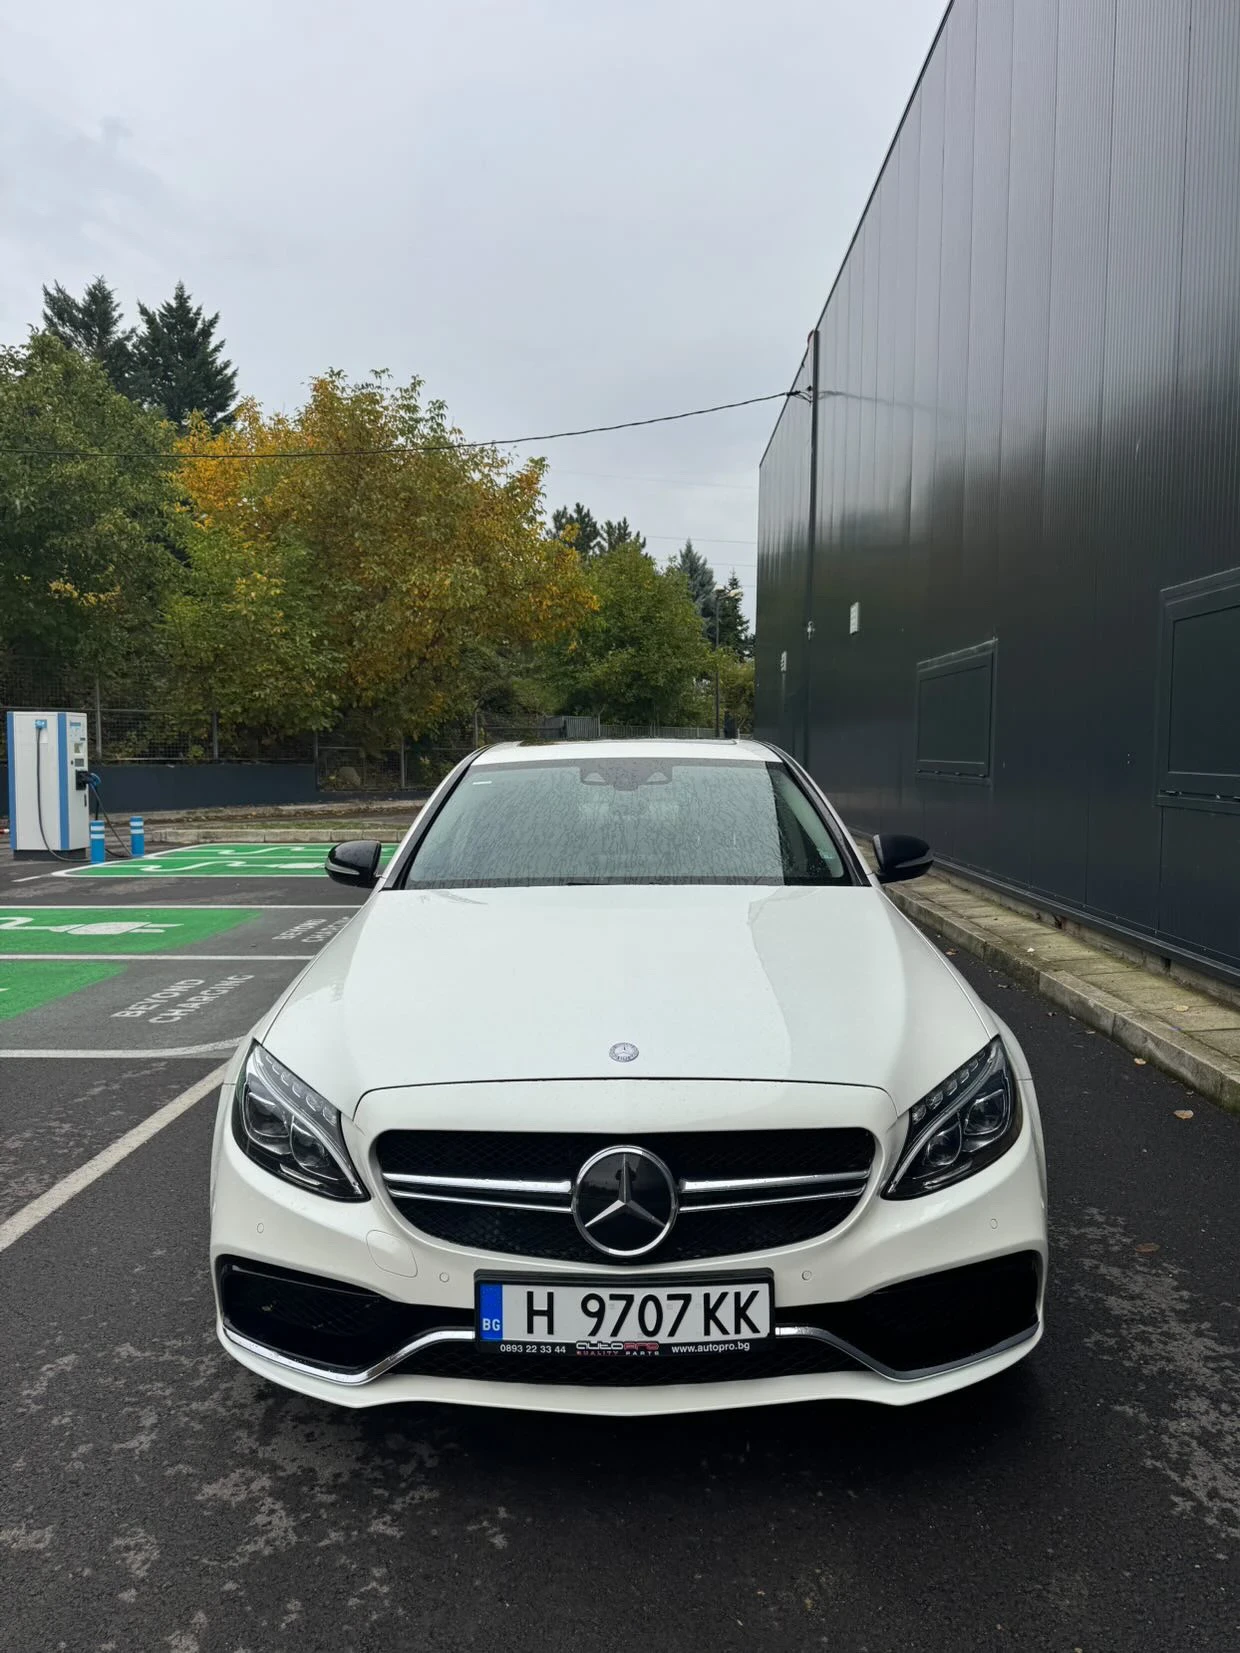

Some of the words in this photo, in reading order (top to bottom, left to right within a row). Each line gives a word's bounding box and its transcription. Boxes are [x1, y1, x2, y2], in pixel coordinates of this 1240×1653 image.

[271, 918, 328, 940] BEYOND
[110, 978, 205, 1018] BEYOND
[149, 974, 255, 1024] CHARGING
[482, 1317, 501, 1332] BG
[526, 1290, 555, 1336] H
[580, 1292, 693, 1338] 9707
[703, 1289, 761, 1337] KK
[500, 1344, 523, 1353] 0893
[525, 1345, 538, 1353] 22
[539, 1345, 552, 1354] 33
[554, 1345, 567, 1354] 44
[671, 1342, 751, 1354] www.autopro.bg
